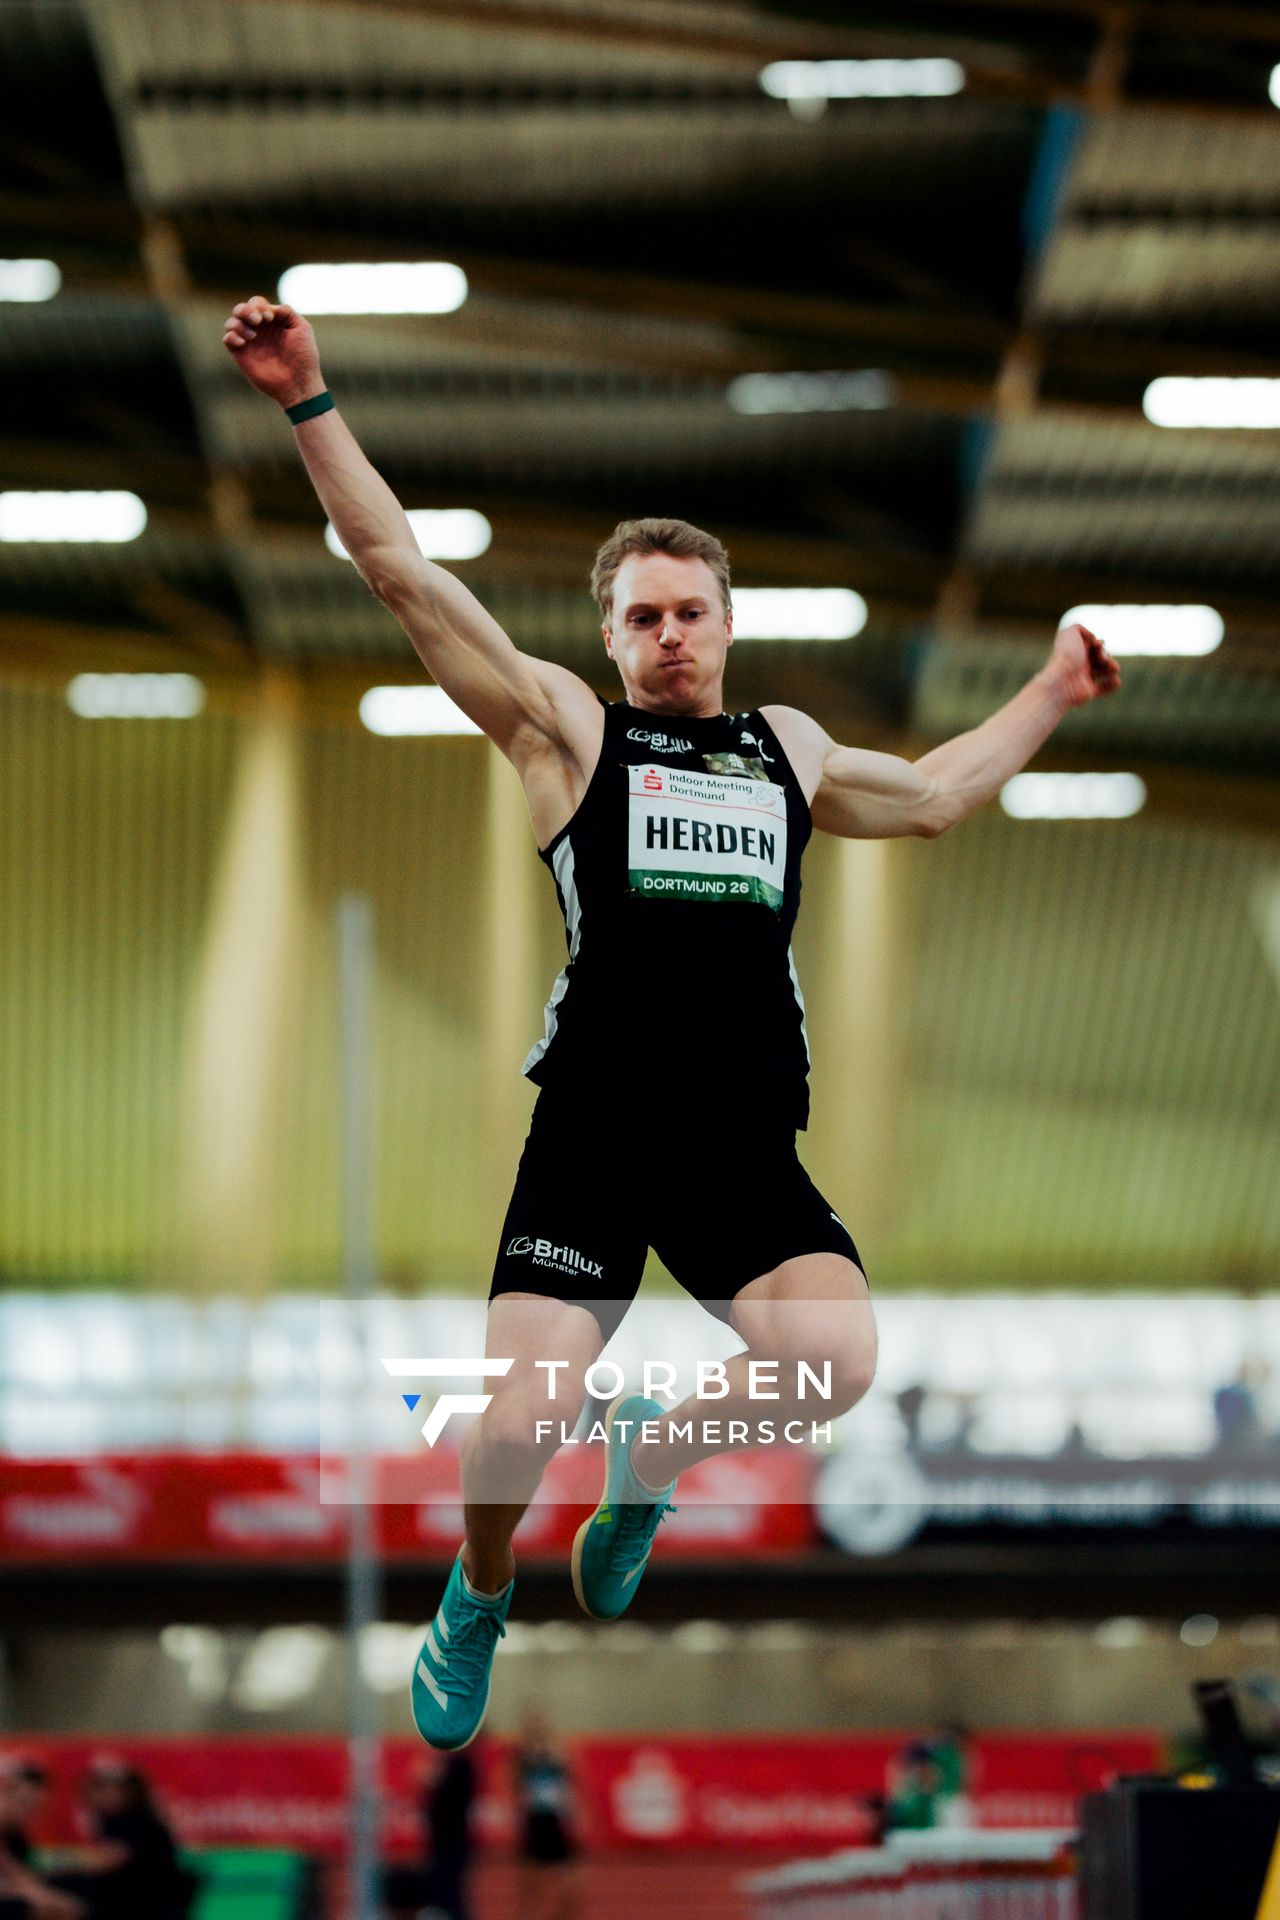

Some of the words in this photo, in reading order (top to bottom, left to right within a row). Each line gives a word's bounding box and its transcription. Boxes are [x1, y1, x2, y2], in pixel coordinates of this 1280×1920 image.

[669, 772, 703, 786] Indoor
[707, 779, 753, 795] Meeting
[669, 784, 725, 801] Dortmund
[646, 815, 775, 865] HERDEN
[643, 877, 727, 893] DORTMUND
[730, 881, 750, 894] 26
[532, 1256, 579, 1276] Münster
[534, 1238, 603, 1279] Brillux
